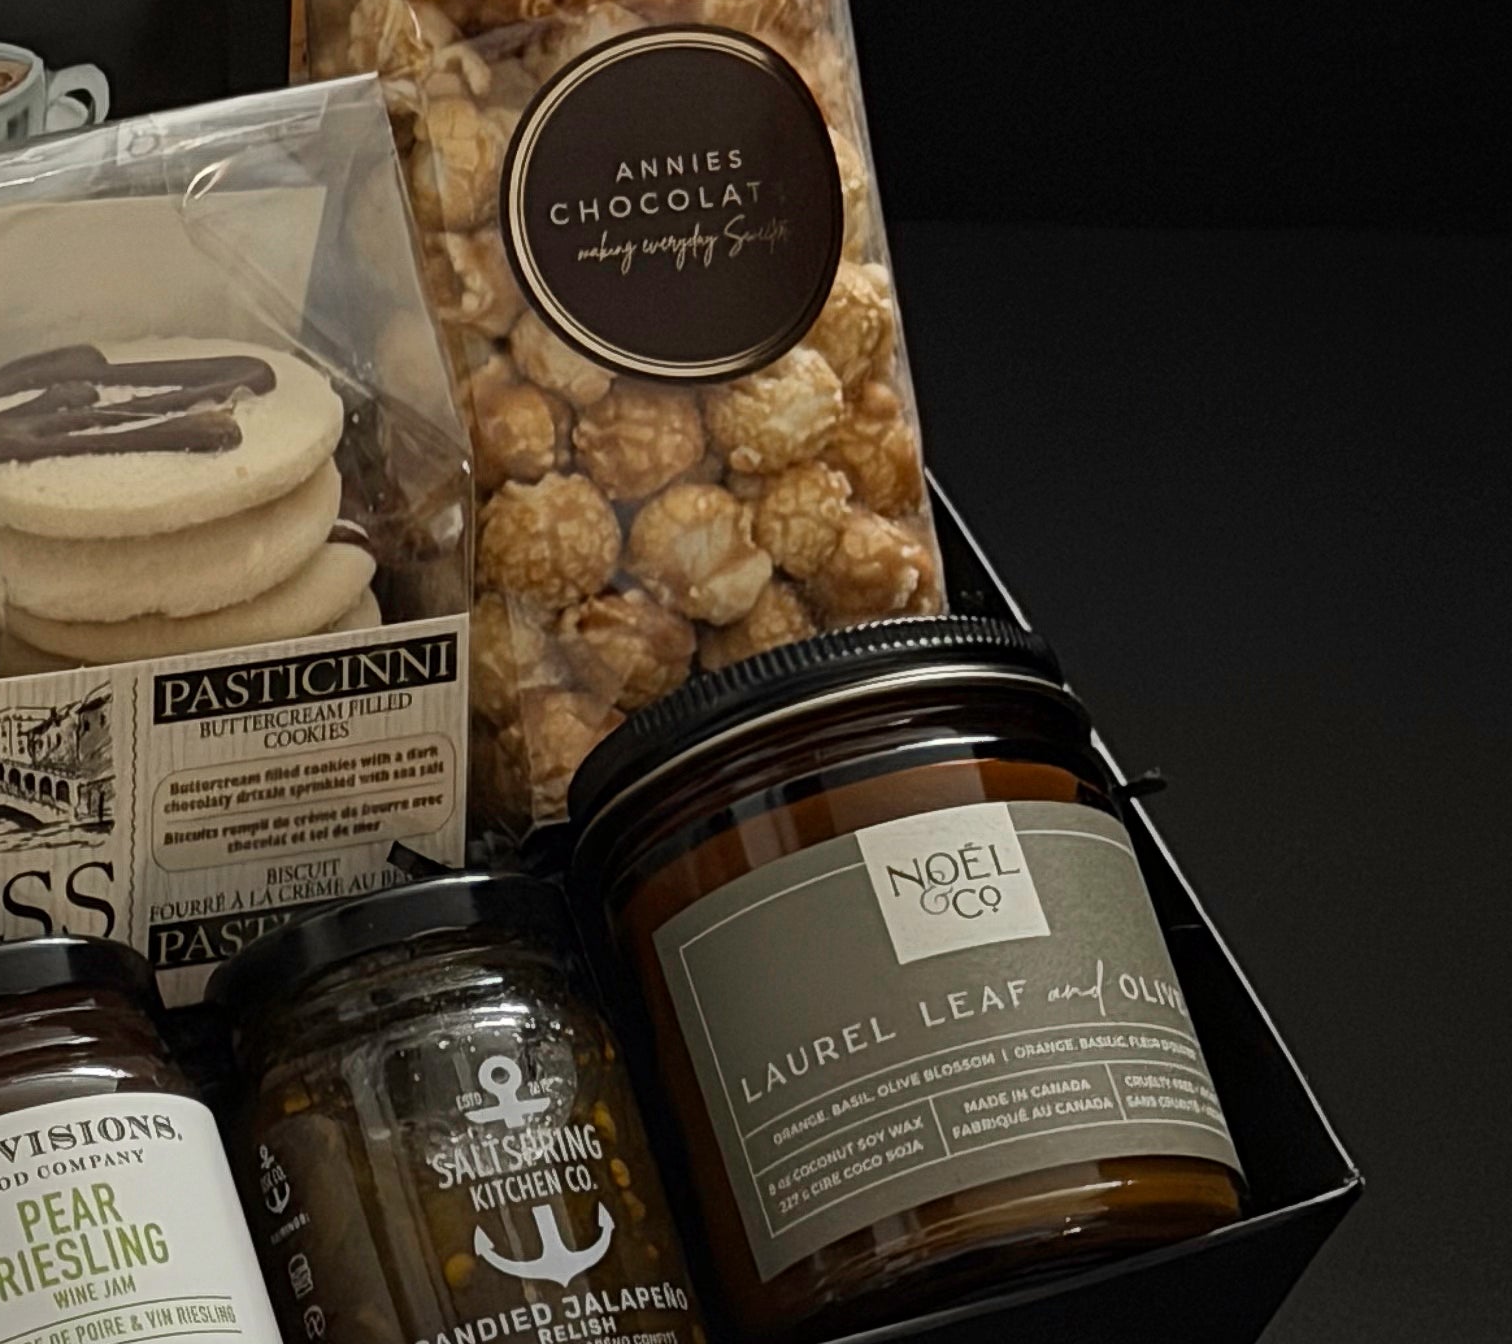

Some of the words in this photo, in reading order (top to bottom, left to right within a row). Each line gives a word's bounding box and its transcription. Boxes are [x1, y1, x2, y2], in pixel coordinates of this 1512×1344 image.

[615, 149, 743, 184] ANNIES
[550, 181, 762, 226] CHOCOLAT
[160, 640, 453, 718] PASTICINNI
[199, 702, 345, 738] BUTTERCREAM
[348, 691, 413, 720] FILLED
[263, 721, 350, 749] COOKIES
[361, 752, 391, 768] with
[249, 887, 273, 907] LA
[346, 871, 375, 893] AU
[266, 858, 341, 885] BISCUIT
[741, 1017, 896, 1103] LAUREL
[919, 979, 1027, 1027] LEAF
[1047, 959, 1106, 1017] and
[877, 1072, 921, 1098] OLIVE
[923, 1053, 995, 1083] BLOSSOM
[964, 1093, 1007, 1114] MADE
[1012, 1087, 1027, 1103] IN
[1030, 1079, 1091, 1098] CANADA
[1032, 1105, 1052, 1120] AU
[1055, 1096, 1113, 1115] CANADA
[36, 1148, 145, 1179] COMPANY
[793, 1145, 854, 1182] COCONUT
[857, 1130, 885, 1151] SOY
[888, 1116, 923, 1138] WAX
[811, 1174, 841, 1196] CIRE
[844, 1156, 882, 1179] COCO
[885, 1139, 923, 1162] SOJA
[469, 1167, 562, 1212] KITCHEN
[565, 1164, 599, 1193] CO.
[16, 1182, 123, 1244] PEAR
[53, 1285, 99, 1311] WINE
[104, 1275, 137, 1299] JAM
[563, 1281, 688, 1320] JALAPEÑO
[130, 1314, 144, 1331] &
[149, 1308, 173, 1328] VIN
[177, 1303, 237, 1327] RIESLING
